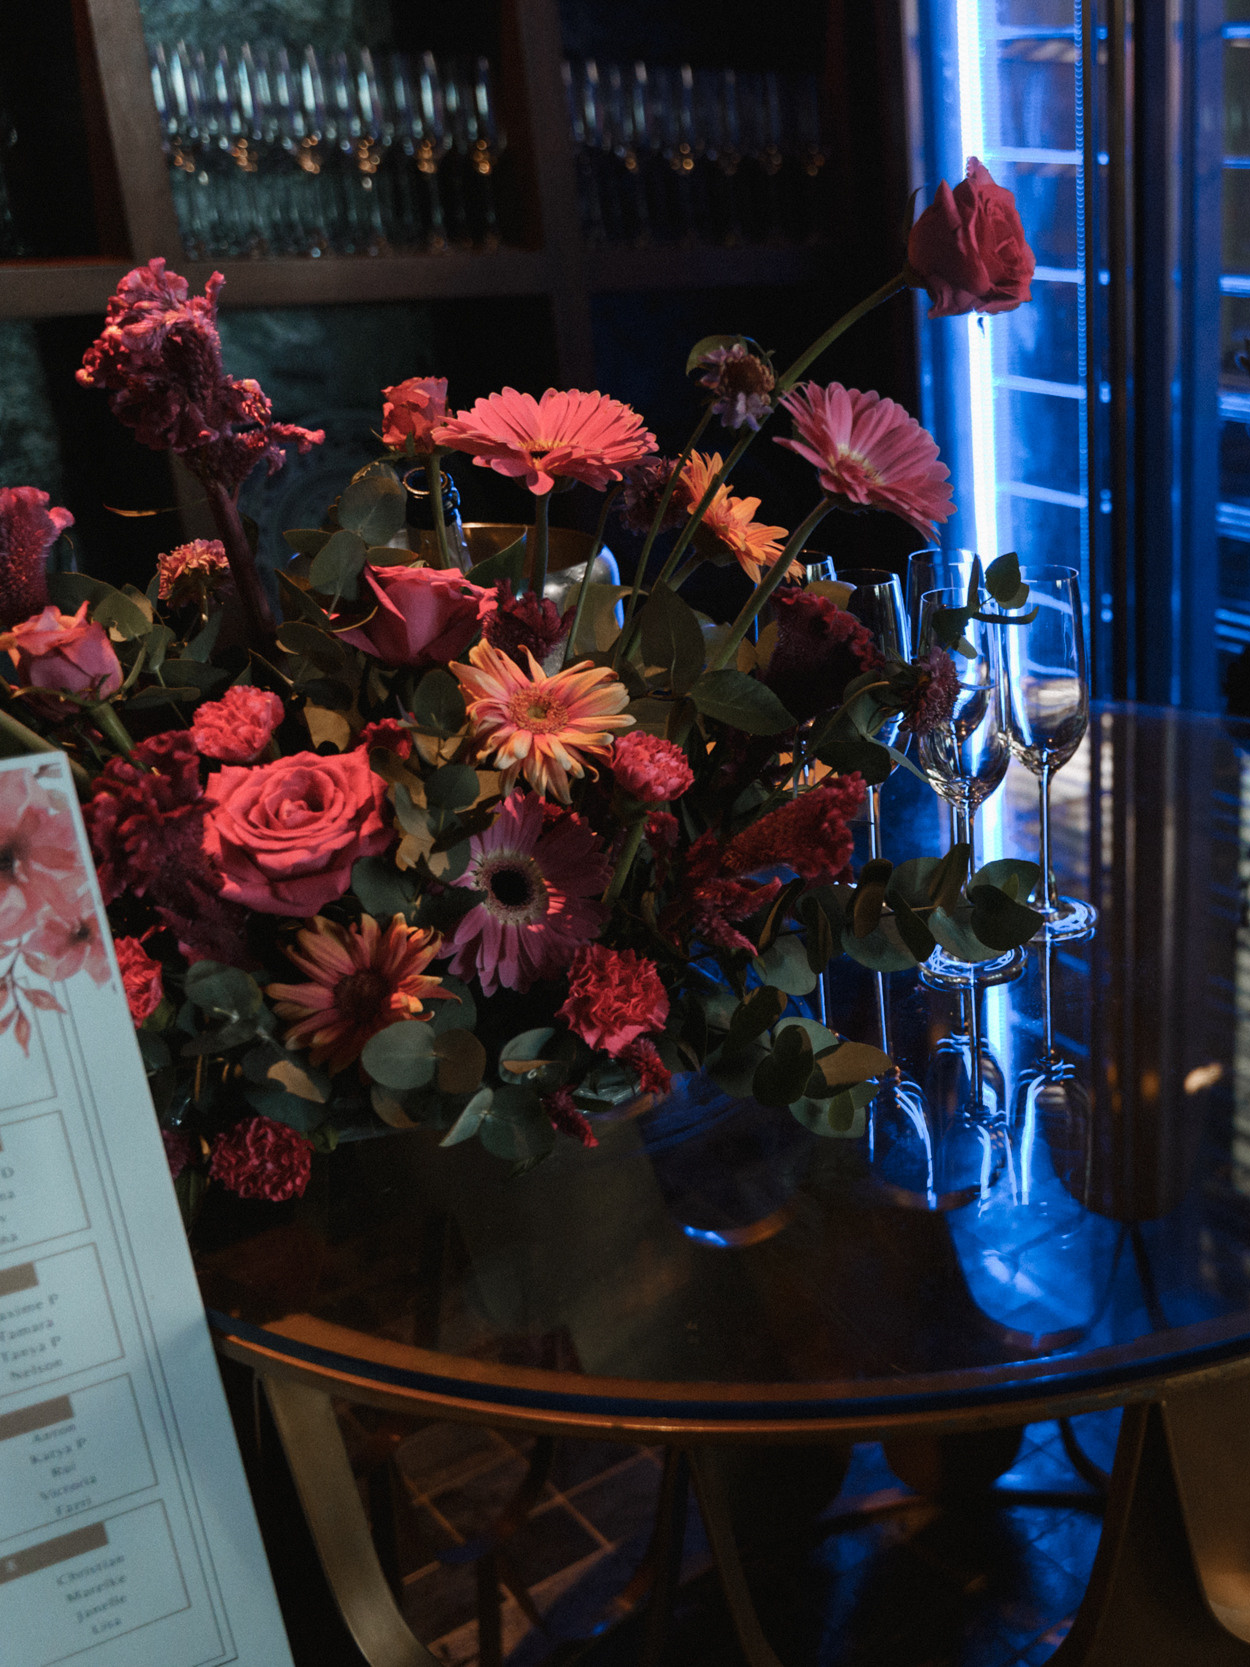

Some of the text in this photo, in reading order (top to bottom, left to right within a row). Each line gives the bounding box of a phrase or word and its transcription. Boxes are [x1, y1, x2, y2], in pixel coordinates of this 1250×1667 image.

[48, 1293, 59, 1305] P
[51, 1335, 62, 1348] P
[11, 1359, 63, 1379] Nelson
[29, 1437, 87, 1465] Katya P
[39, 1475, 97, 1500] Victoria
[56, 1554, 125, 1586] Christian
